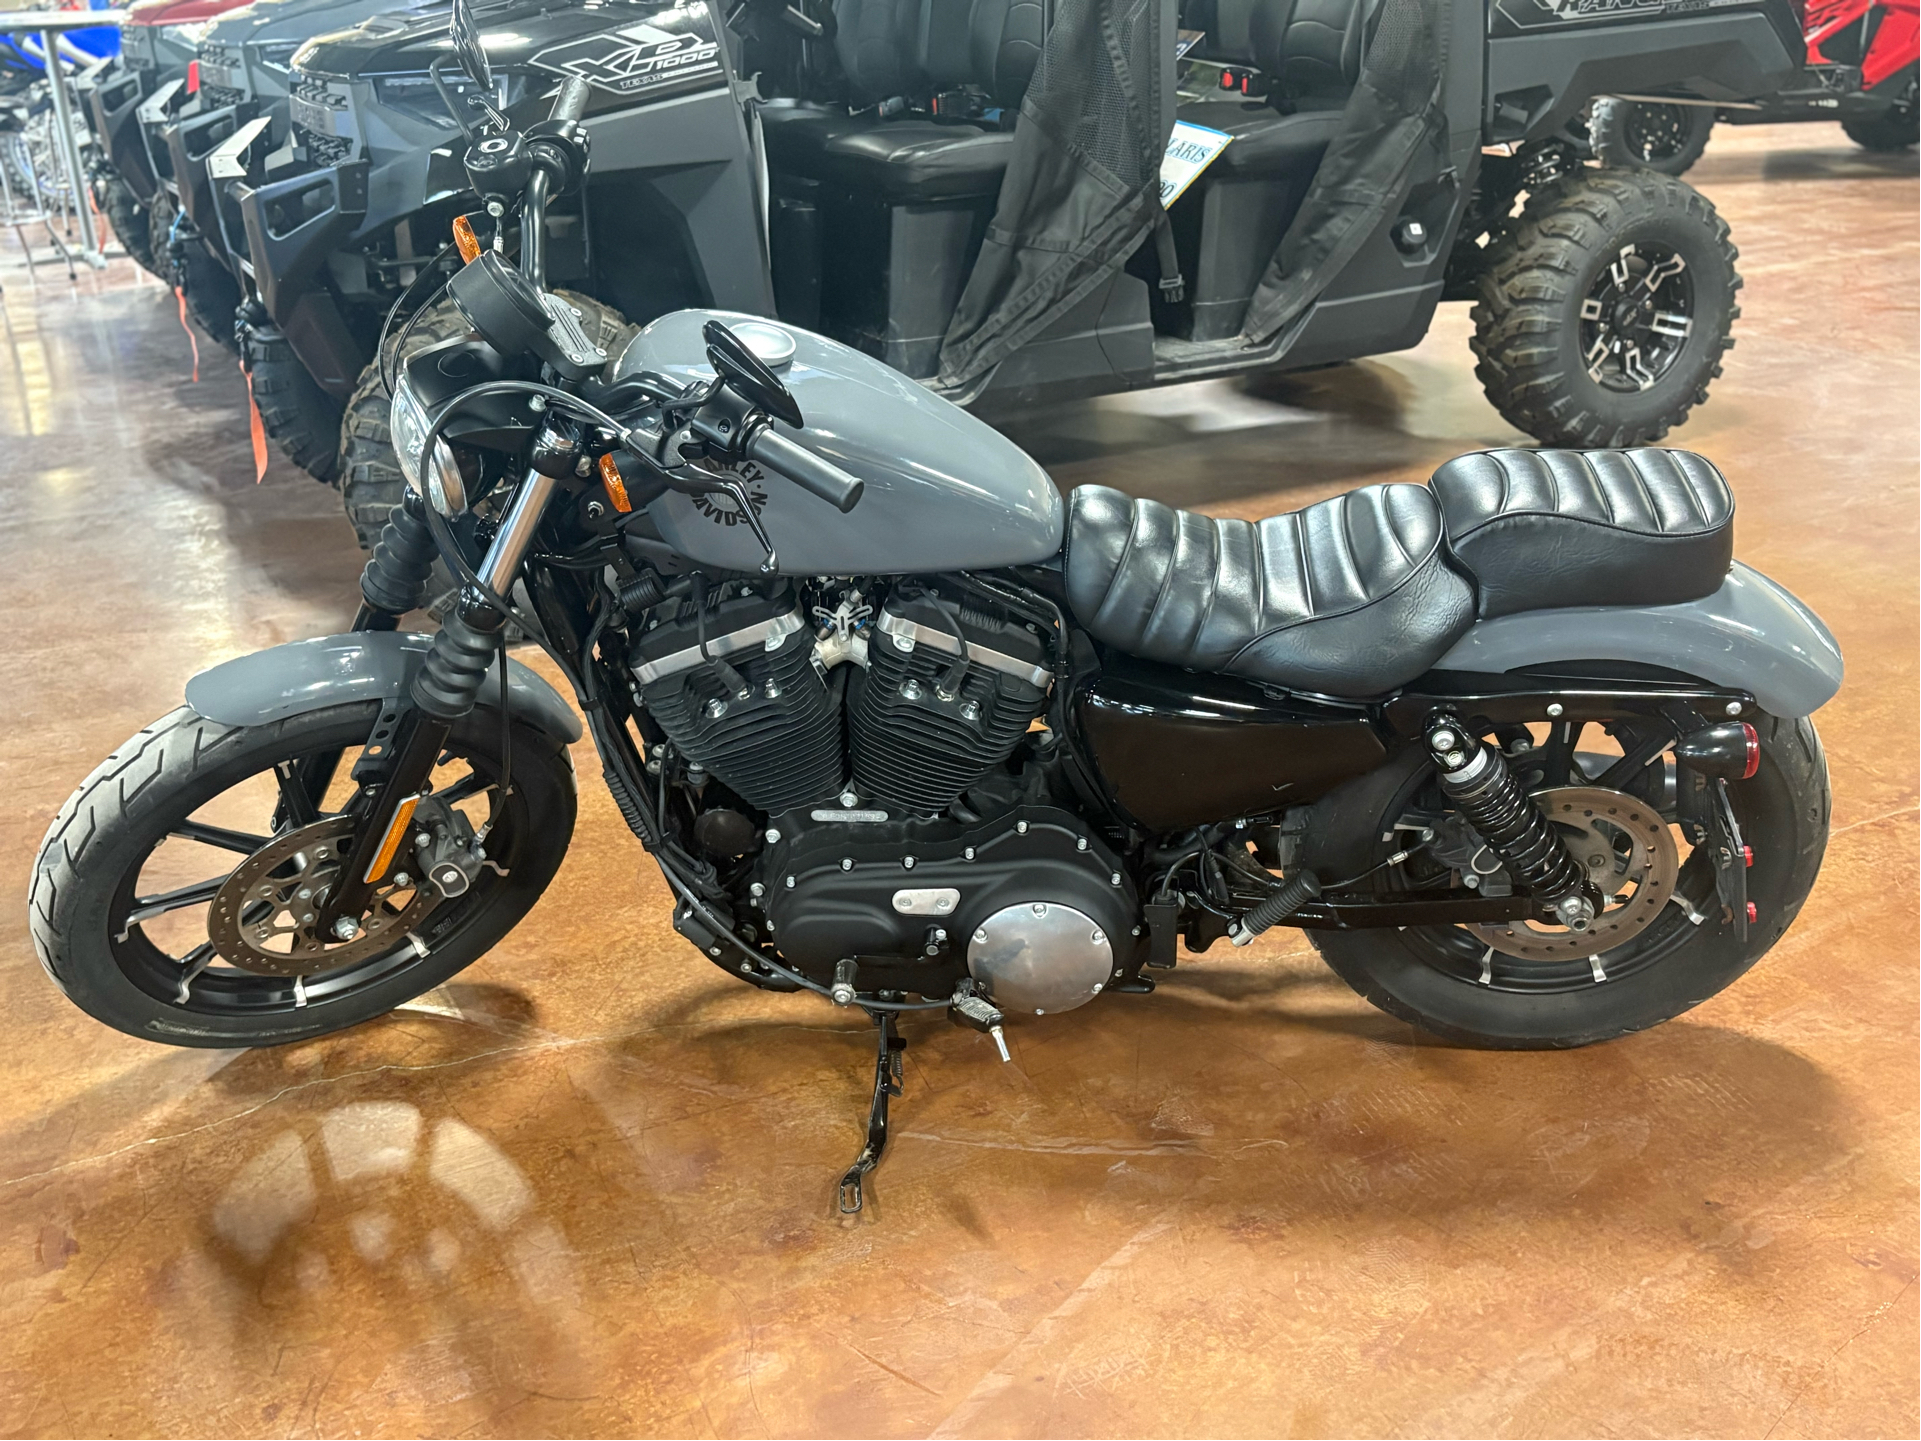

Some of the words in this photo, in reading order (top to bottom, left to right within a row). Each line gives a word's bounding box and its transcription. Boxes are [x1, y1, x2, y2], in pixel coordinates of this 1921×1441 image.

[656, 47, 717, 70] 1000
[1166, 138, 1212, 164] LARIS
[703, 458, 764, 483] ALEY
[690, 491, 768, 526] AVIDSN
